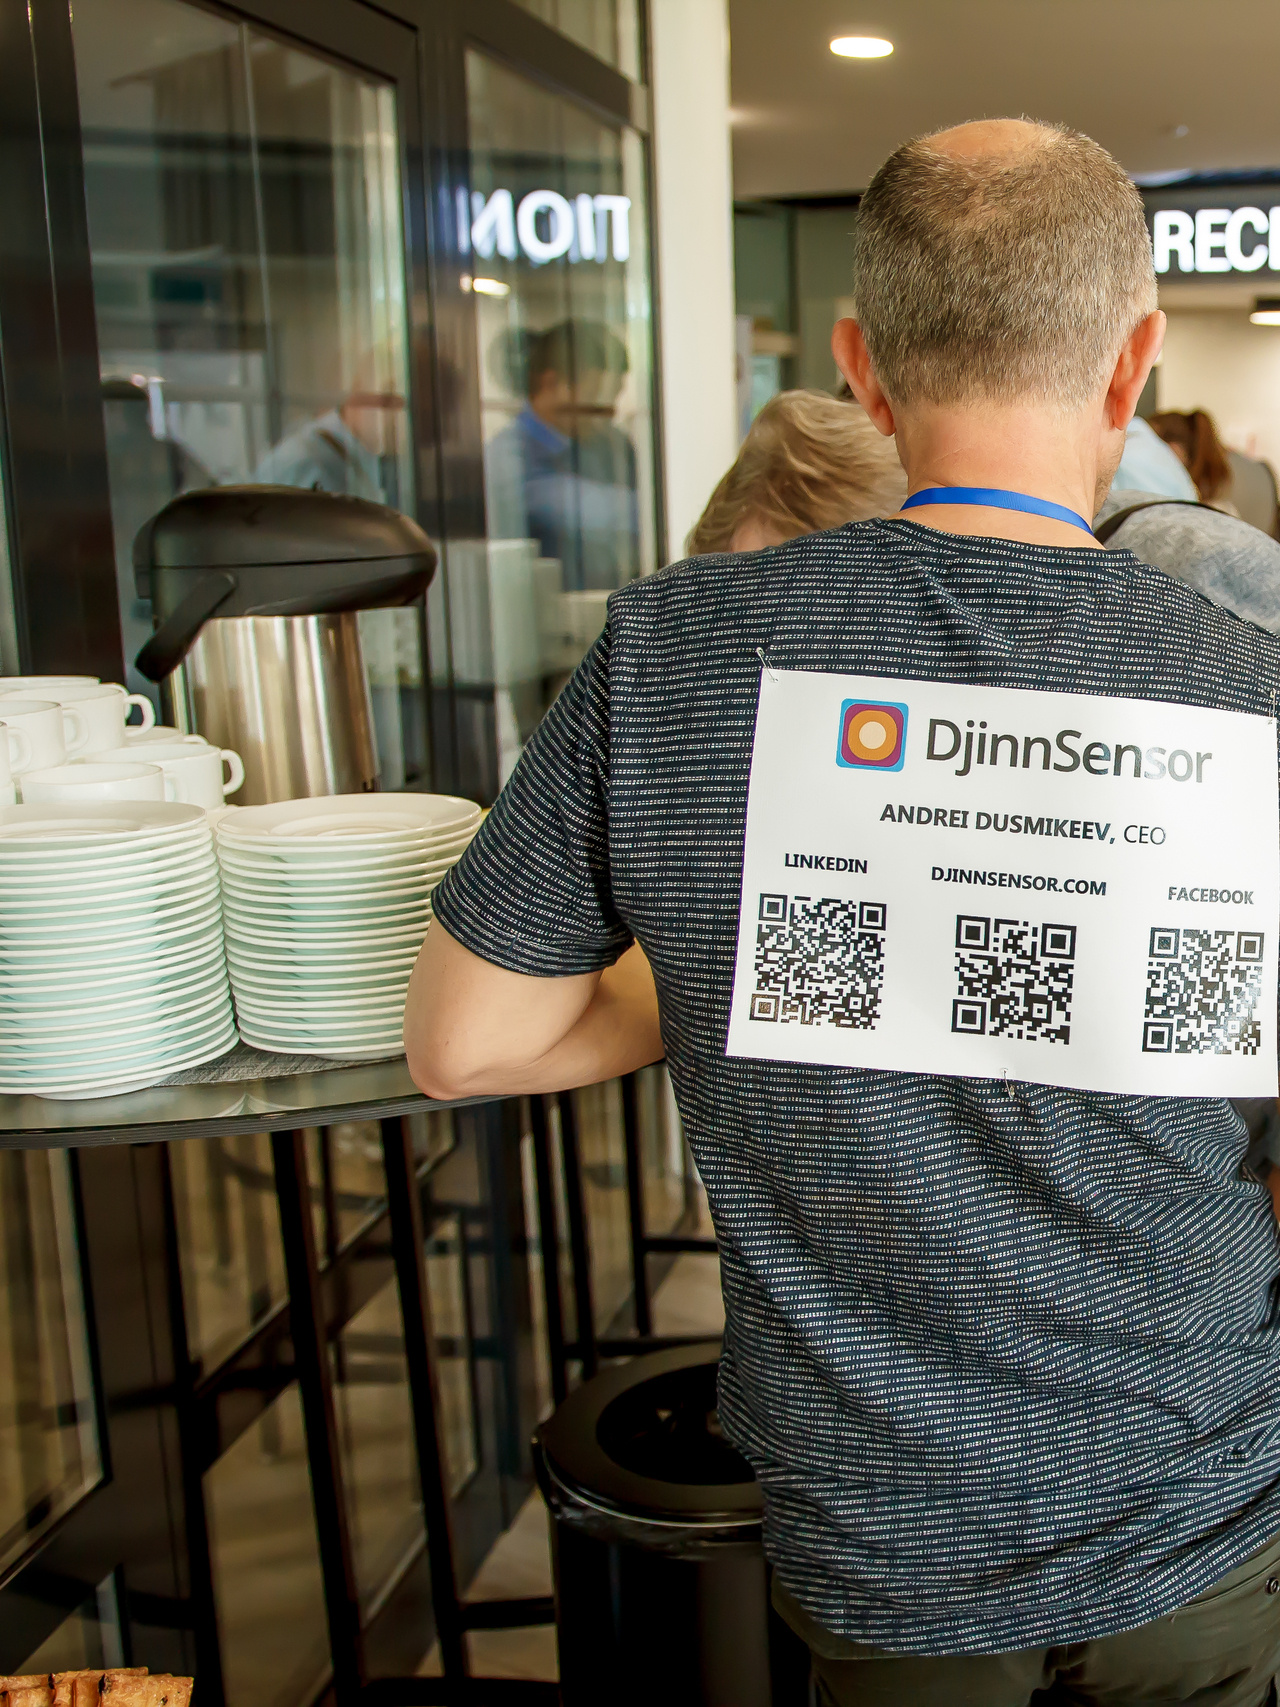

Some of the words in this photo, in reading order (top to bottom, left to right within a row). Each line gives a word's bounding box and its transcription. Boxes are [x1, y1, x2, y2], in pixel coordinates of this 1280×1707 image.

[926, 718, 1212, 783] DjinnSensor
[880, 804, 969, 829] ANDREI
[976, 812, 1115, 844] DUSMIKEEV,
[1124, 825, 1166, 845] CEO
[785, 853, 867, 874] LINKEDIN
[931, 866, 1107, 895] DJINNSENSOR.COM
[1168, 886, 1254, 904] FACEBOOK
